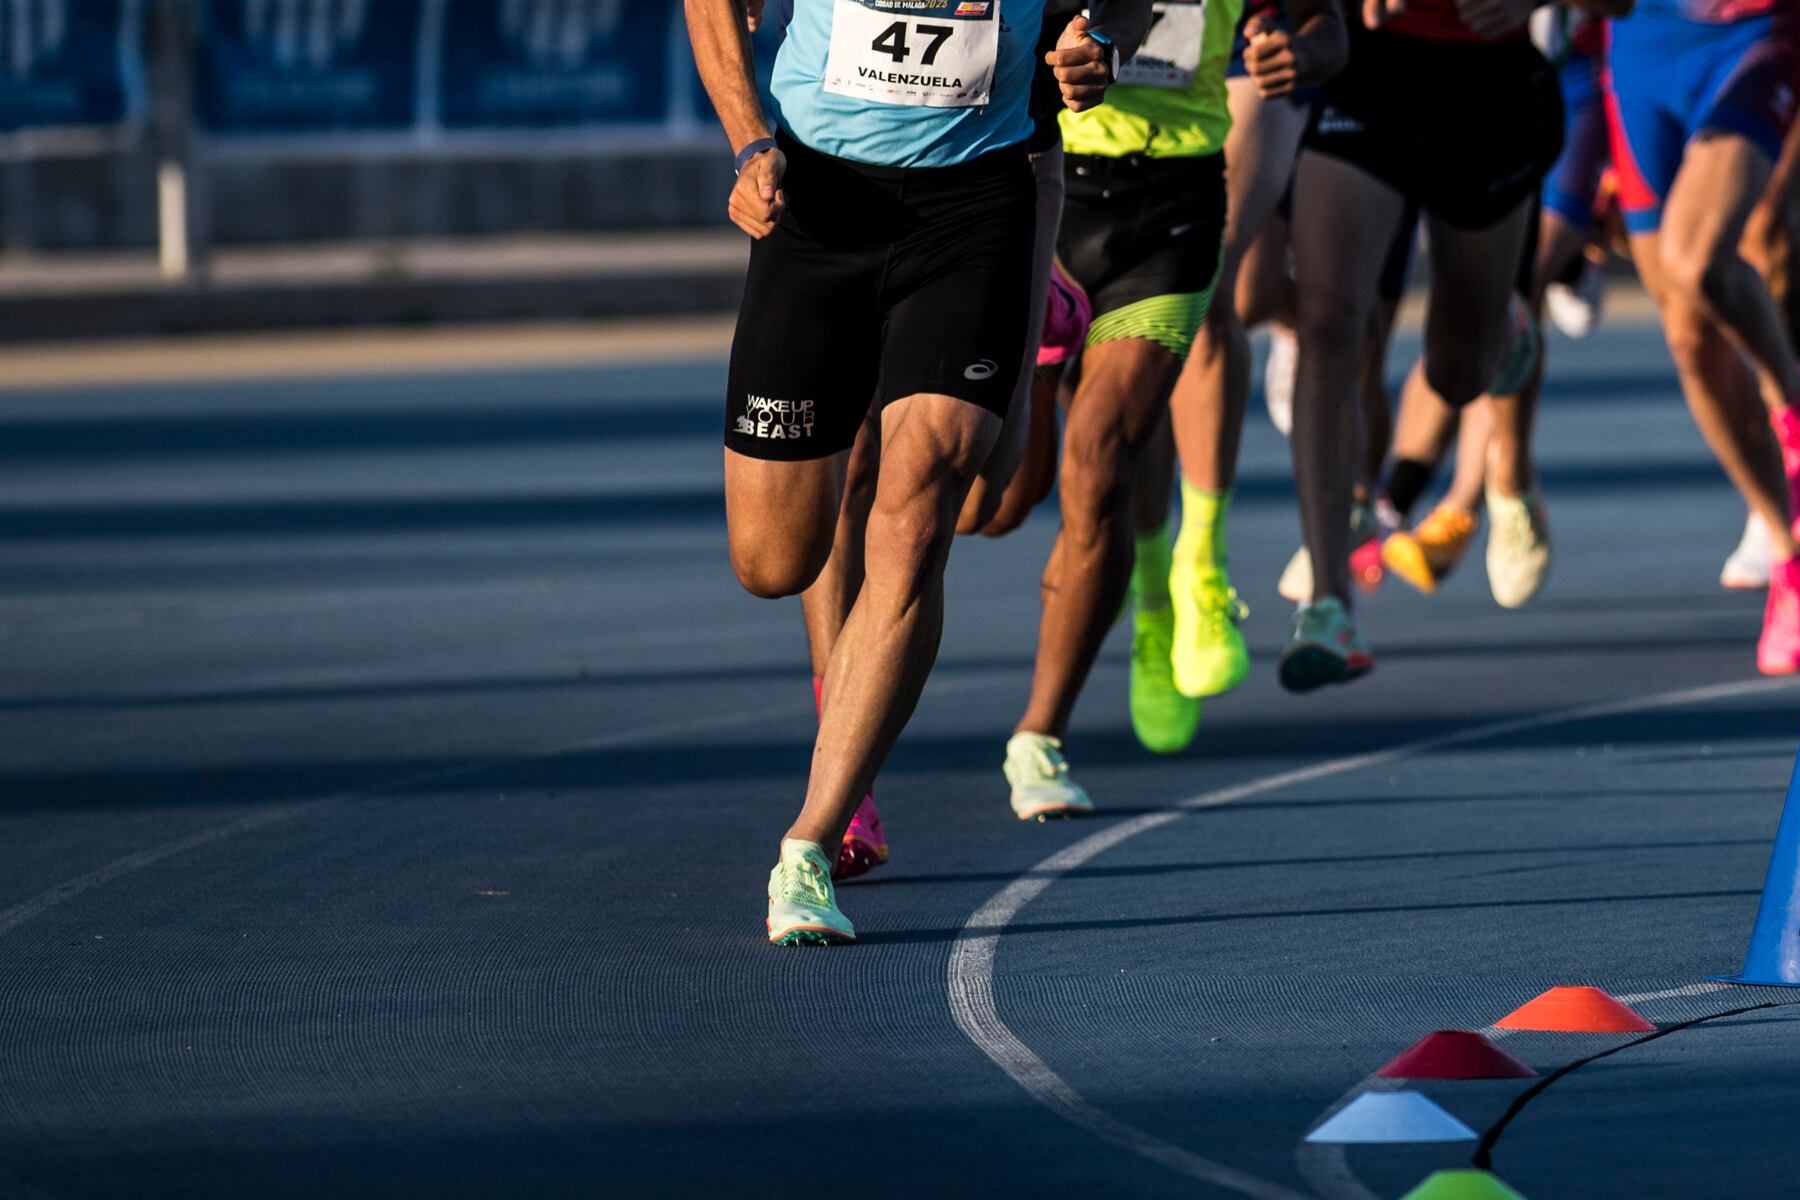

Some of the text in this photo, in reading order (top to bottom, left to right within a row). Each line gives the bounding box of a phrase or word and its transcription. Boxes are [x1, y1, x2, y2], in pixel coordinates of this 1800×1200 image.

[871, 21, 954, 65] 47
[858, 66, 963, 88] VALENZUELA
[747, 393, 814, 414] WAKE UP
[746, 404, 815, 426] YOUR
[747, 419, 814, 440] BEAST
